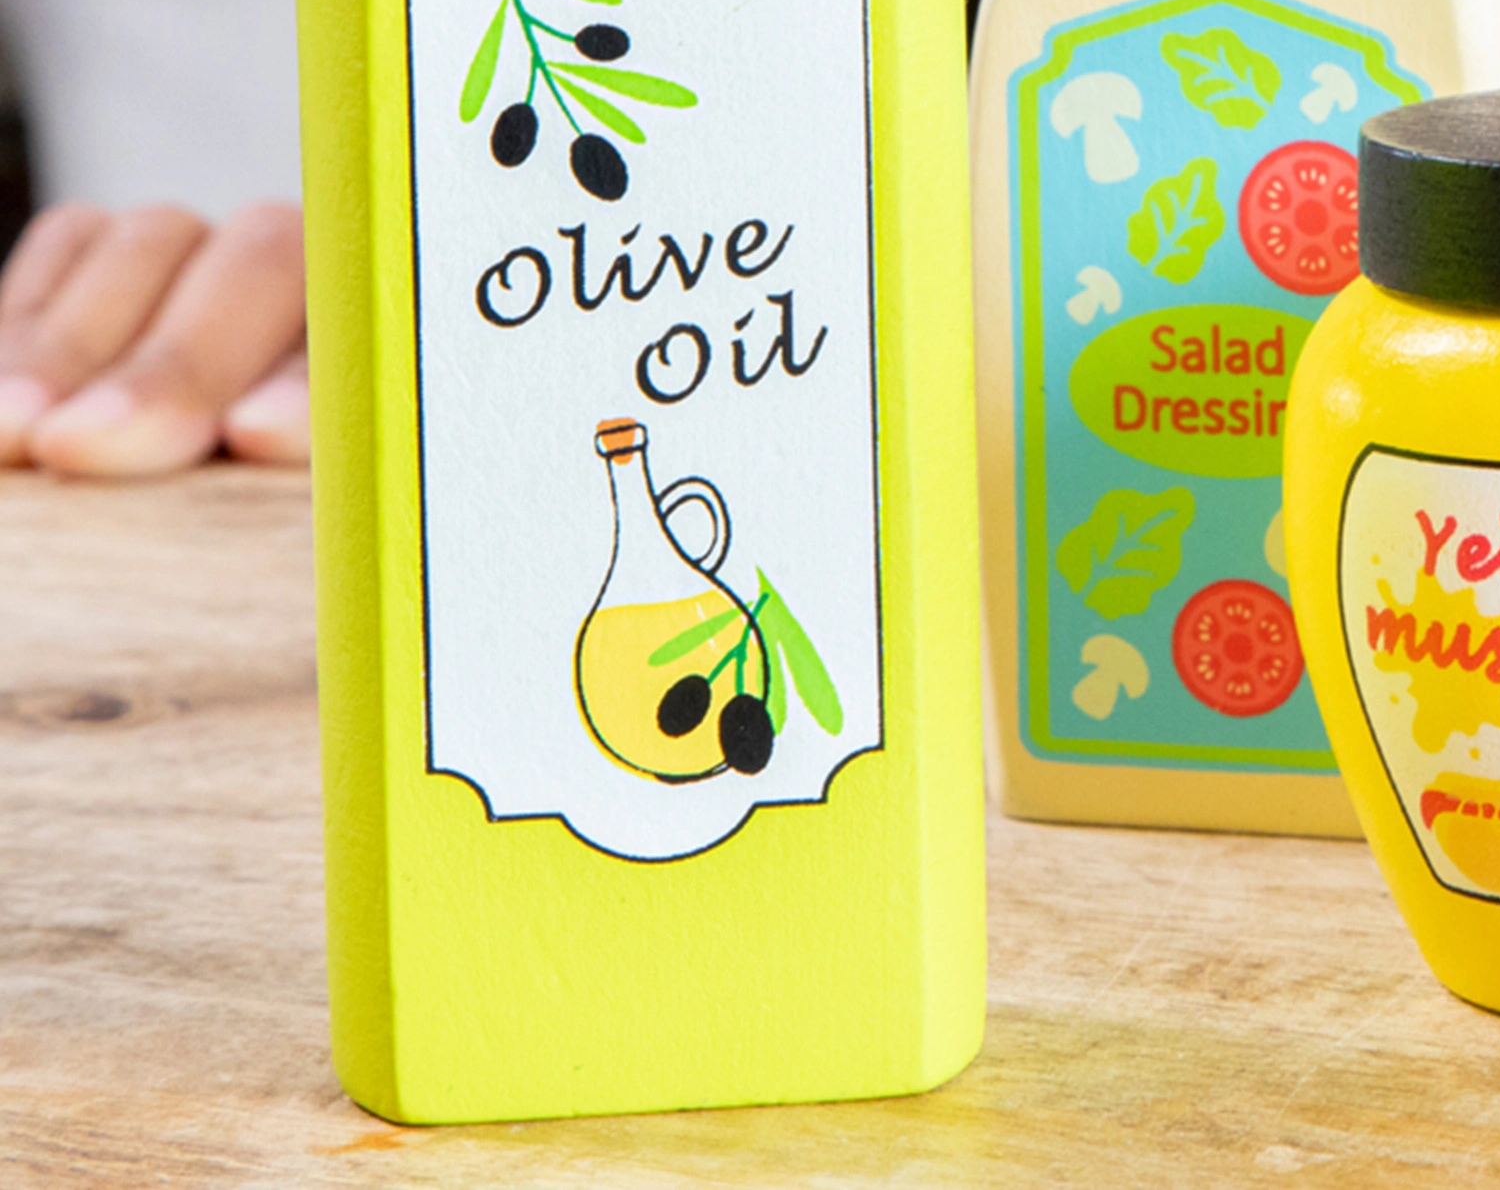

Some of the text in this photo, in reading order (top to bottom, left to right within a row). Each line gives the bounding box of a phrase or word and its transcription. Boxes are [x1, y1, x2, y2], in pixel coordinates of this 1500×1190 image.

[475, 218, 795, 328] Olive
[635, 289, 829, 404] Oil
[1149, 323, 1286, 376] Salad
